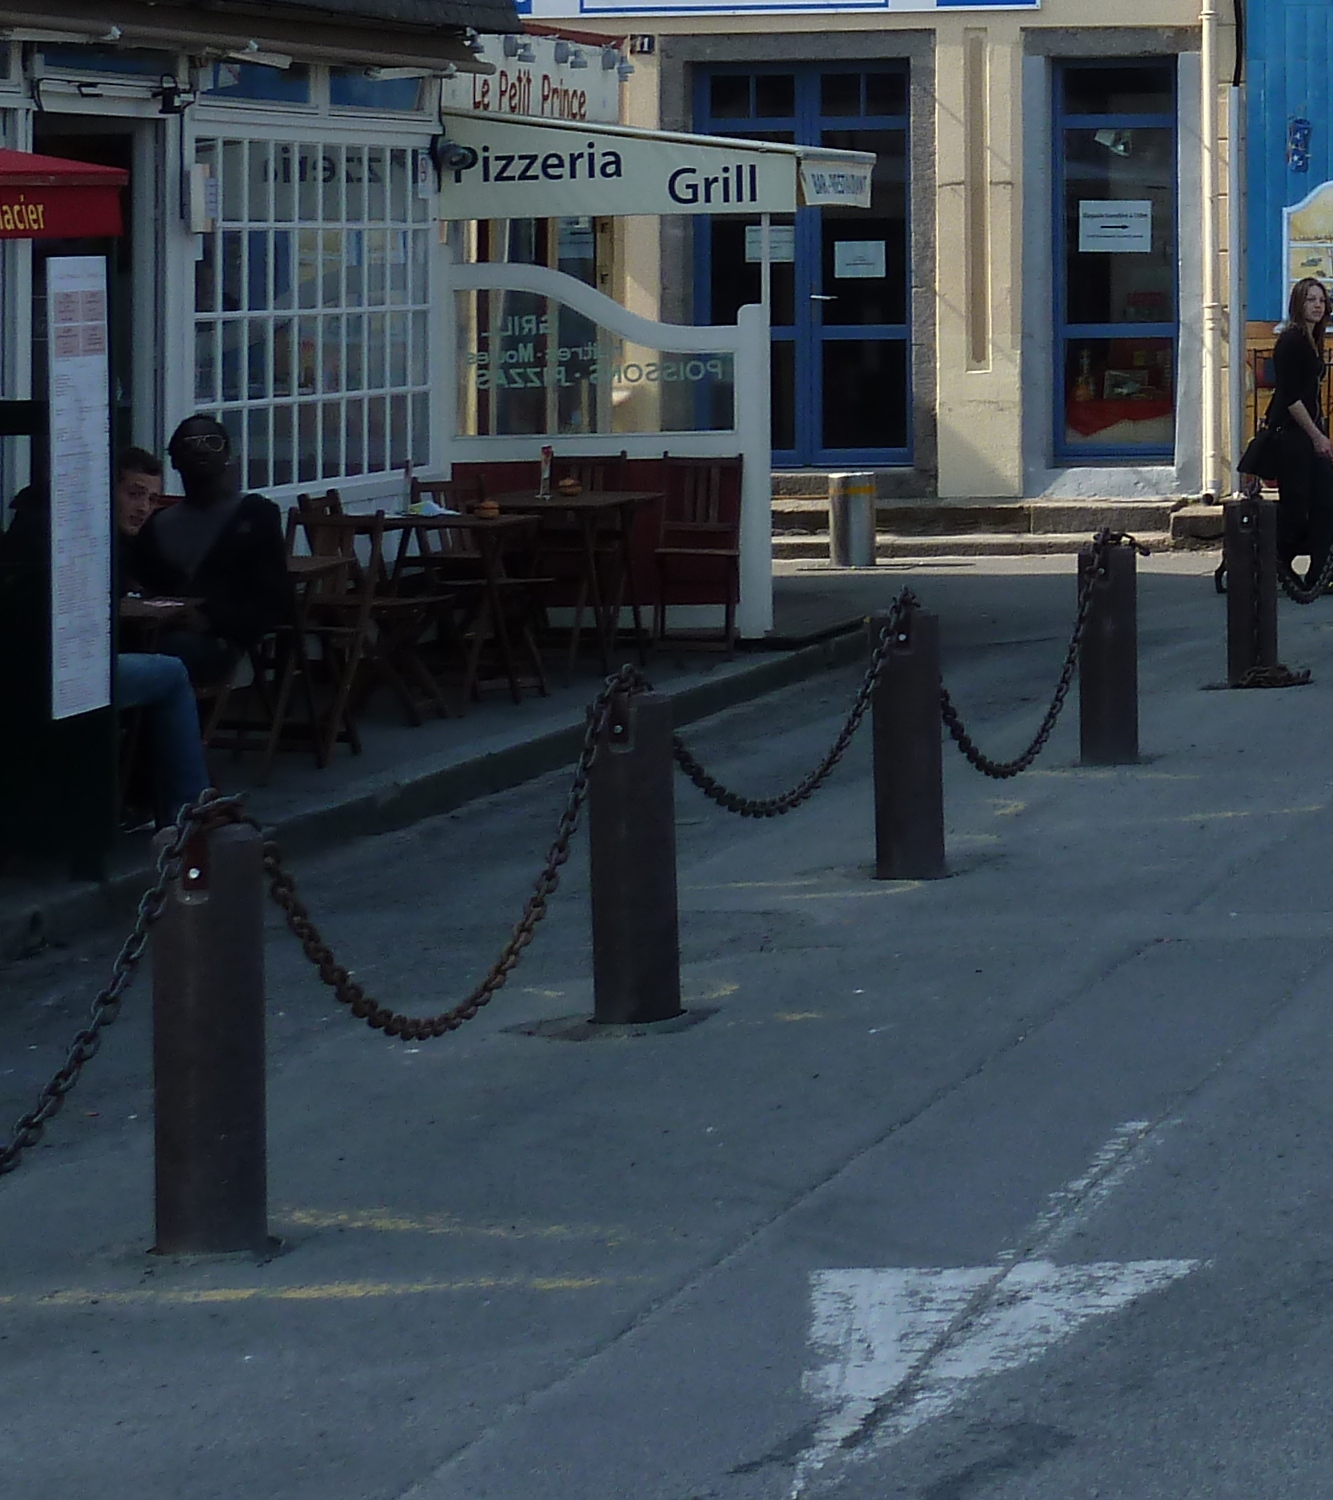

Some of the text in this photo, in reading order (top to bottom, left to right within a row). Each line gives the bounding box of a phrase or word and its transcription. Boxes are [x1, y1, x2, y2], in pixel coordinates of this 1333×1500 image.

[472, 66, 588, 121] Le Petit Prince
[454, 141, 623, 184] Pizzeria
[667, 164, 758, 205] Grill
